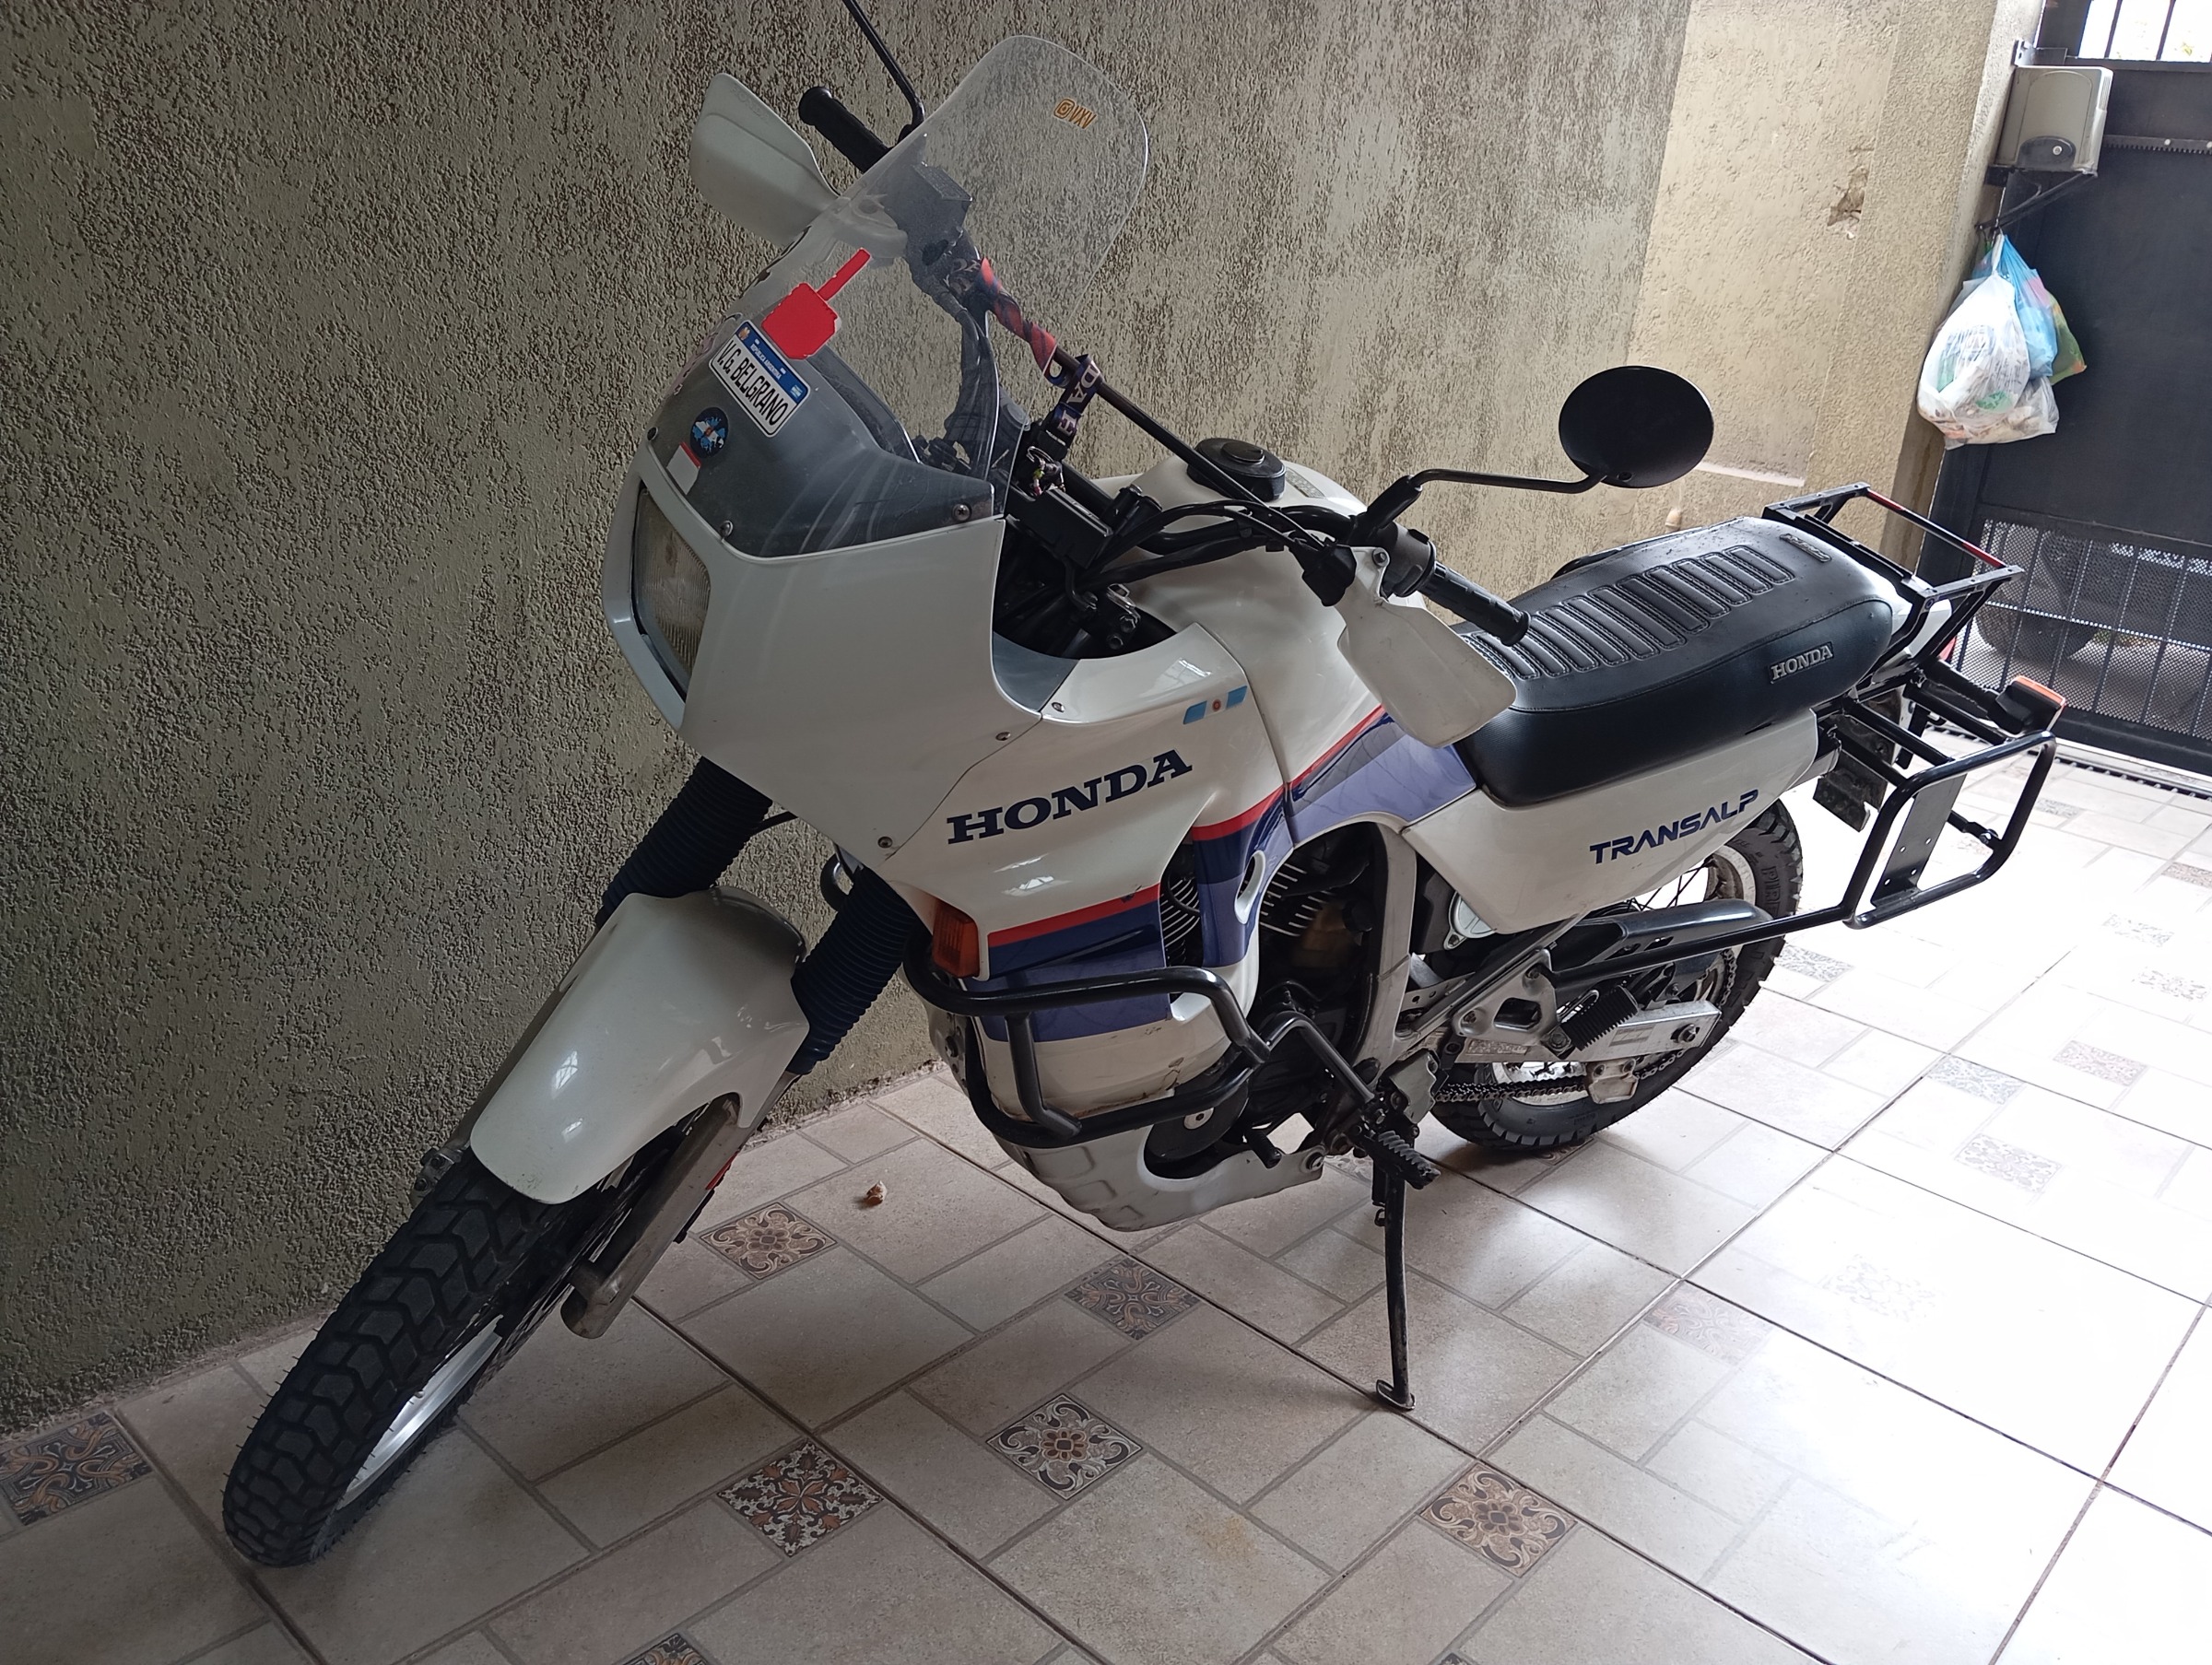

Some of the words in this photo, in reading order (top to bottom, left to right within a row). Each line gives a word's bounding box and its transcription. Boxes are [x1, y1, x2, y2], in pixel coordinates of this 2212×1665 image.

[730, 357, 788, 426] BELGRANO
[1771, 645, 1833, 680] HONDA
[947, 749, 1193, 844] HONDA
[1589, 789, 1759, 864] TRANSALP
